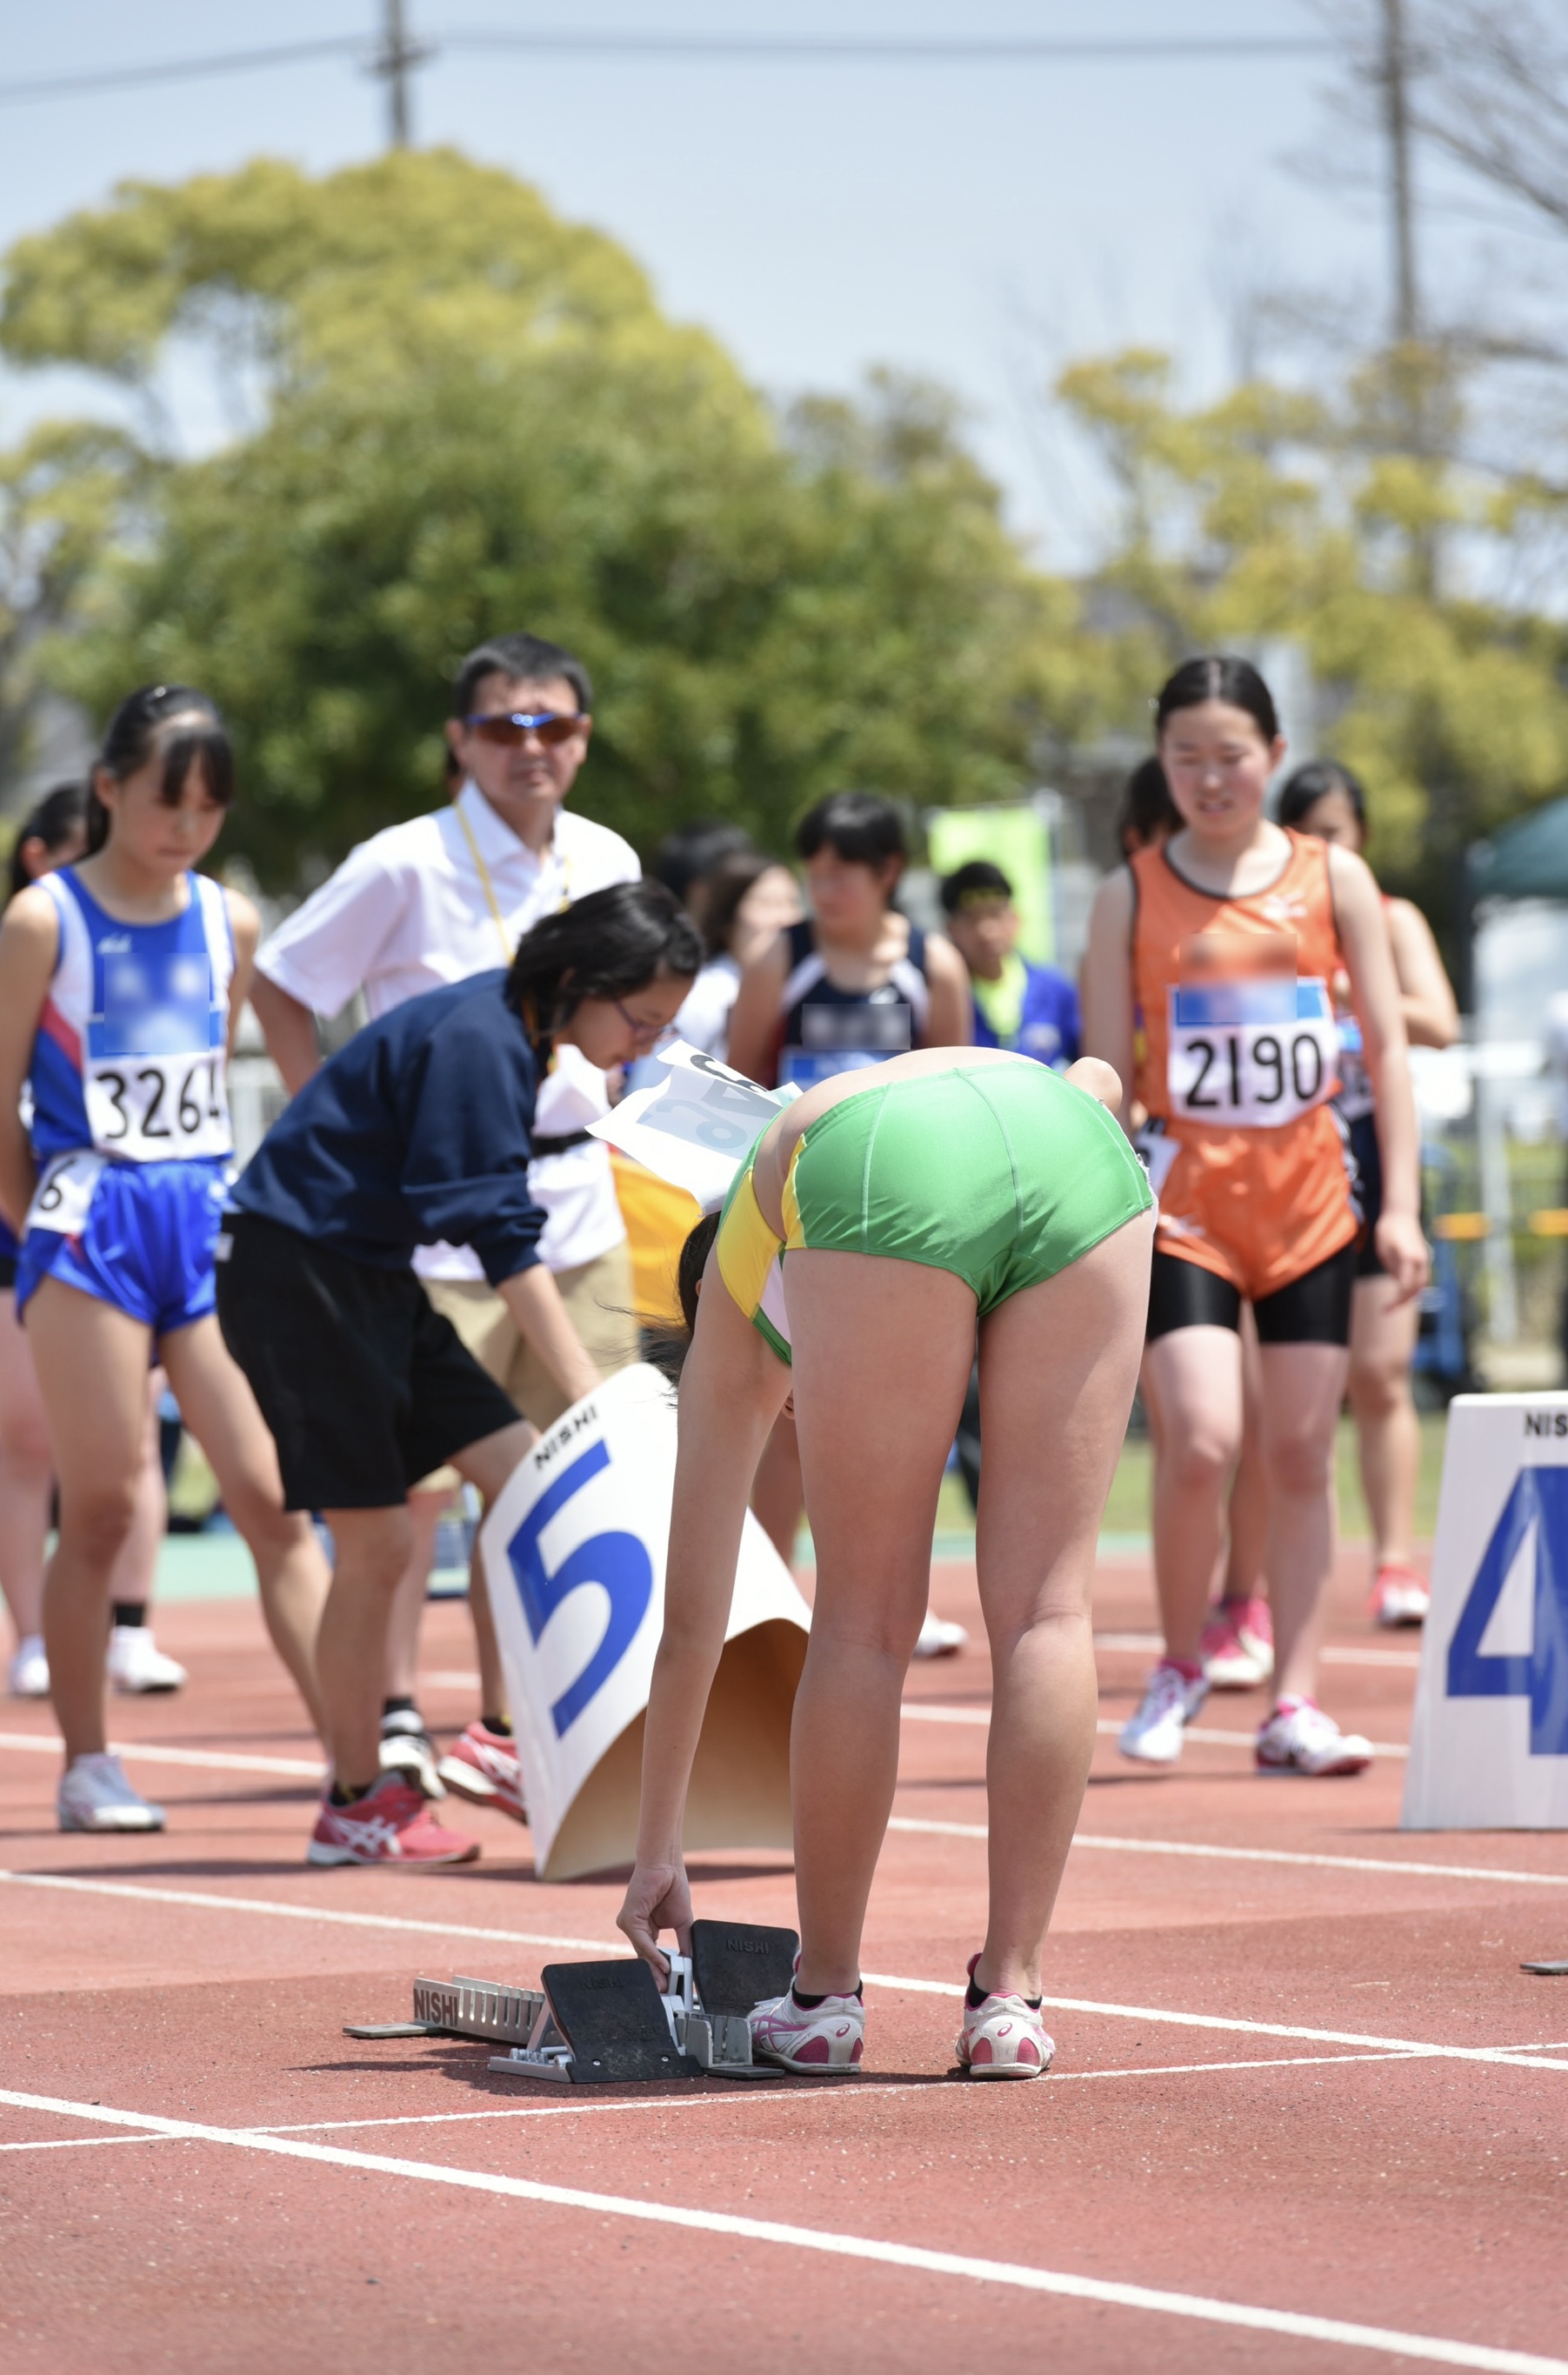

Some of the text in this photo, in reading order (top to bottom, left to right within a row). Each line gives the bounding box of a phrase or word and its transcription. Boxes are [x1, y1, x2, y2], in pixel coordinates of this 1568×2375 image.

[1185, 1034, 1323, 1110] 2190
[39, 1157, 77, 1211] 6
[534, 1404, 597, 1470] NISHI
[507, 1438, 655, 1740] 5
[1446, 1464, 1568, 1756] 4
[725, 1938, 770, 1956] NISHI
[413, 1988, 458, 2027] NISHI
